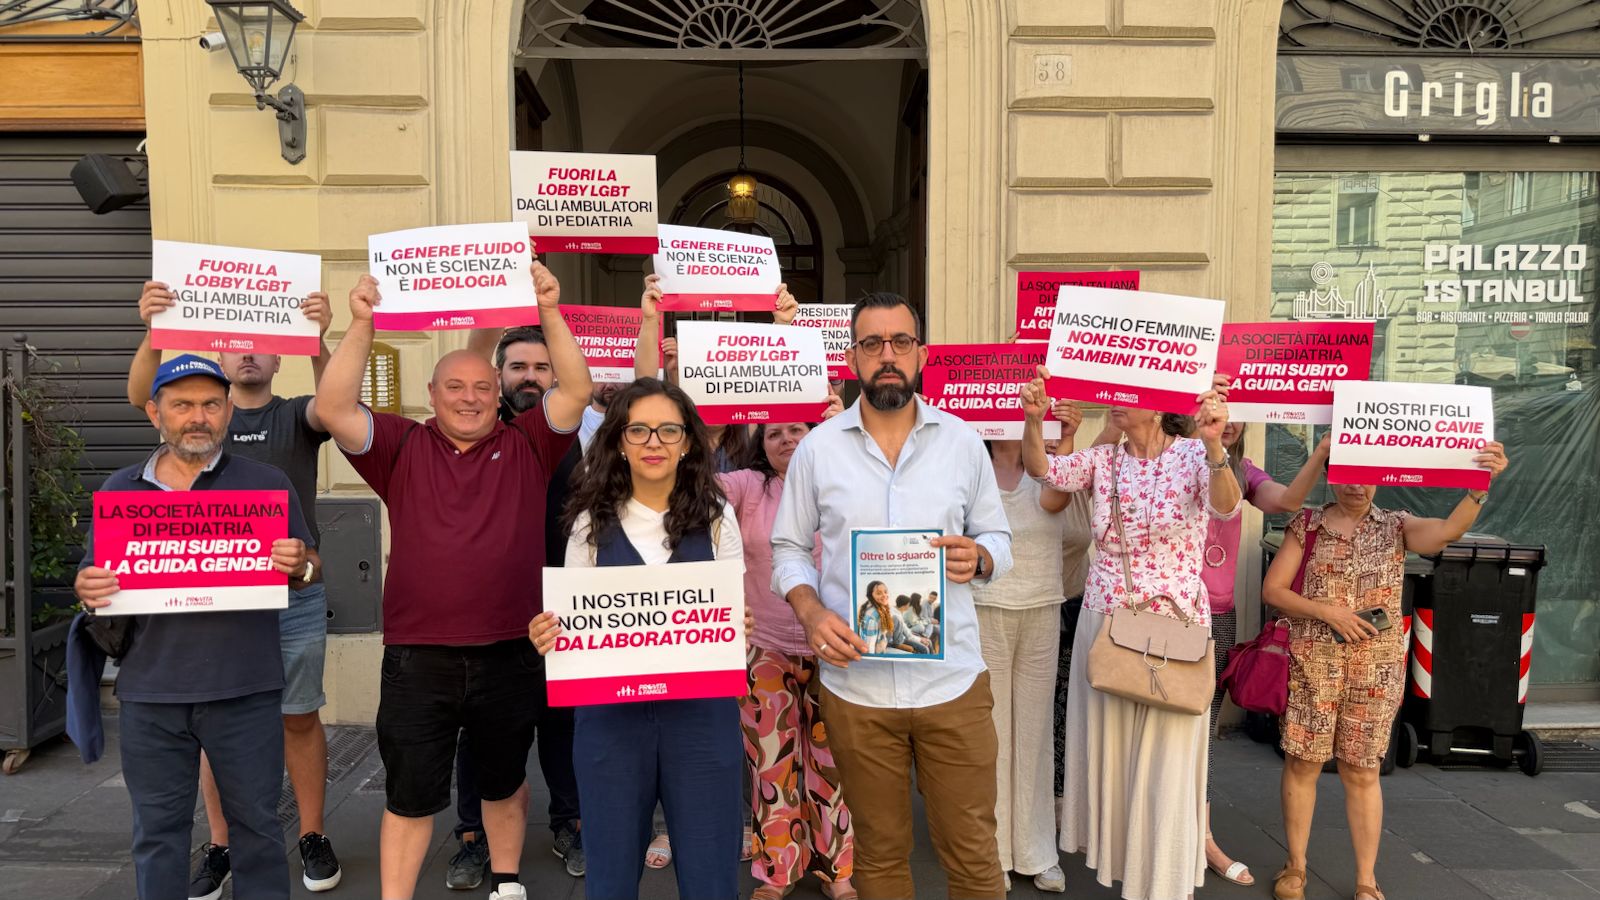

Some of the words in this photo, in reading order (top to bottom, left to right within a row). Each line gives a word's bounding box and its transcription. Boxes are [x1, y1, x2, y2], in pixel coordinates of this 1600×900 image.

[1384, 70, 1553, 125] Griglia
[548, 167, 595, 181] FUORI
[597, 169, 617, 181] LA
[538, 183, 588, 196] LOBBY
[590, 185, 630, 197] LGBT
[517, 198, 558, 211] DAGLI
[561, 200, 652, 213] AMBULATORI
[538, 215, 552, 227] DI
[556, 215, 633, 227] PEDIATRIA
[374, 251, 388, 263] IL
[391, 244, 461, 260] GENERE
[464, 241, 526, 256] FLUIDO
[671, 240, 724, 251] GENERE
[727, 243, 773, 256] FLUIDO
[666, 251, 695, 262] NON
[698, 250, 706, 262] È
[709, 253, 768, 265] SCIENZA:
[1424, 244, 1587, 271] PALAZZO
[199, 259, 254, 275] FUORI
[255, 264, 278, 276] LA
[386, 262, 422, 276] NON
[426, 259, 437, 274] È
[440, 257, 517, 274] SCIENZA:
[677, 262, 685, 275] È
[687, 265, 760, 276] IDEOLOGIA
[185, 274, 246, 289] LOBBY
[246, 280, 292, 293] LGBT
[399, 276, 410, 292] È
[413, 274, 507, 291] IDEOLOGIA
[1020, 281, 1035, 291] LA
[1423, 279, 1584, 303] ISTANBUL
[172, 289, 208, 303] AGLI
[211, 292, 309, 309] AMBULATO
[1039, 294, 1050, 304] DI
[183, 306, 199, 319] DI
[203, 307, 292, 324] PEDIATRIA
[571, 314, 616, 324] SOCIETÀ
[1034, 306, 1056, 317] RIT
[1416, 312, 1433, 323] BAR
[1440, 312, 1486, 323] RISTORANTE
[1494, 312, 1527, 323] PIZZERIA
[1535, 312, 1563, 323] TAVOLA
[1564, 312, 1589, 323] CALDA
[575, 325, 586, 334] DI
[1020, 319, 1036, 329] LA
[1057, 312, 1118, 330] MASCHI
[1120, 318, 1133, 332] O
[1135, 320, 1215, 342] FEMMINE:
[606, 337, 639, 348] SUBIT
[717, 335, 765, 347] FUORI
[767, 336, 786, 347] LA
[1067, 330, 1106, 346] NON
[1106, 334, 1197, 357] ESISTONO
[1222, 334, 1239, 346] LA
[1241, 331, 1304, 346] SOCIETÀ
[1305, 333, 1369, 346] ITALIANA
[706, 350, 758, 362] LOBBY
[760, 350, 800, 362] LGBT
[926, 355, 942, 366] LA
[944, 352, 999, 366] SOCIETÀ
[1001, 353, 1047, 366] ITALIAN
[1245, 348, 1260, 360] DI
[1263, 349, 1343, 361] PEDIATRIA
[684, 366, 726, 378] DAGLI
[729, 365, 822, 378] AMBULATORI
[948, 369, 961, 380] DI
[963, 368, 1035, 380] PEDIATRIA
[1239, 363, 1287, 376] RITIRI
[1288, 363, 1348, 377] SUBITO
[706, 382, 720, 394] DI
[724, 380, 803, 393] PEDIATRIA
[943, 383, 986, 395] RITIRI
[1244, 378, 1295, 391] GUIDA
[1297, 379, 1334, 391] GEN
[948, 397, 993, 409] GUIDA
[1357, 402, 1361, 414] I
[1364, 402, 1426, 416] NOSTRI
[1430, 404, 1470, 418] FIGLI
[1343, 417, 1379, 430] NON
[1382, 418, 1431, 432] SONO
[1434, 420, 1484, 434] CAVIE
[1338, 433, 1362, 445] DA
[1364, 434, 1487, 449] LABORATORIO
[99, 505, 124, 519] LA
[126, 501, 206, 519] SOCIETÀ
[207, 503, 284, 518] ITALIANA
[133, 523, 151, 537] DI
[156, 521, 253, 536] PEDIATRIA
[125, 540, 187, 557] RITIRI
[188, 539, 261, 555] SUBITO
[860, 551, 884, 561] Oltre
[886, 552, 895, 560] lo
[897, 550, 936, 562] sguardo
[133, 558, 197, 574] GUIDA
[573, 595, 577, 611] I
[582, 591, 659, 610] NOSTRI
[664, 588, 714, 606] FIGLI
[558, 614, 602, 631] NON
[607, 611, 667, 629] SONO
[671, 607, 732, 625] CAVIE
[554, 636, 584, 652] DA
[587, 627, 736, 650] LABORATORIO
